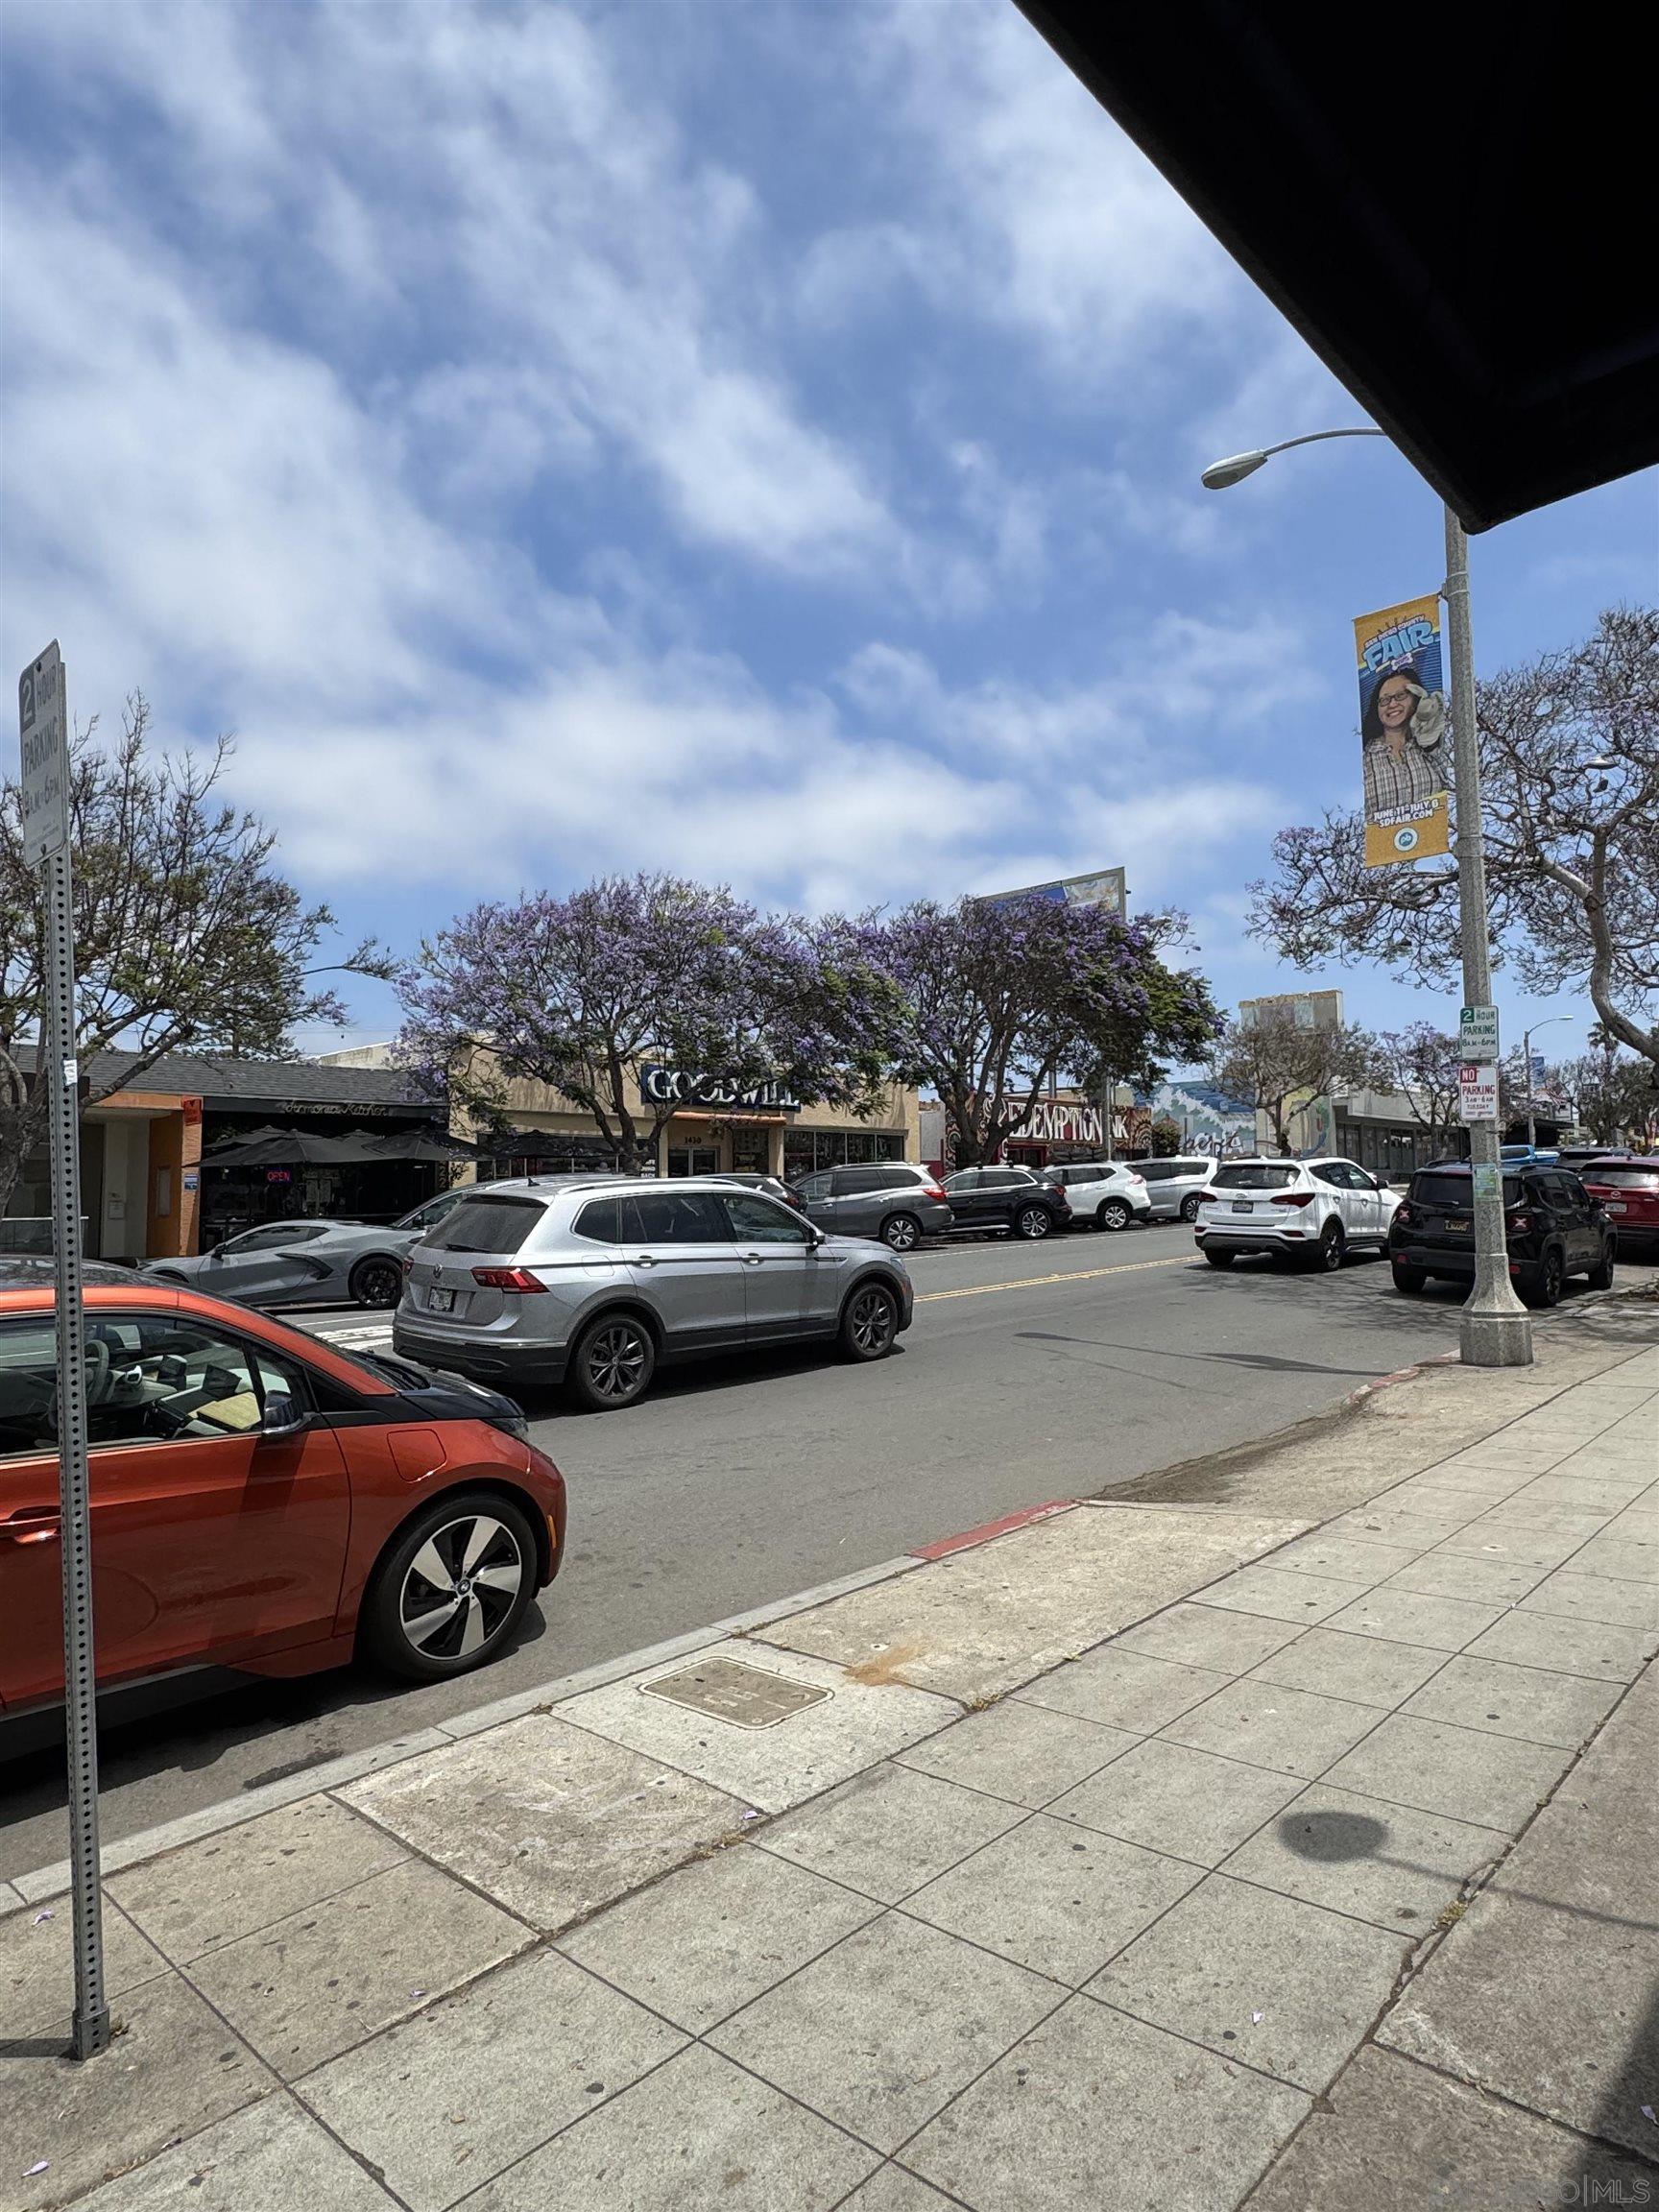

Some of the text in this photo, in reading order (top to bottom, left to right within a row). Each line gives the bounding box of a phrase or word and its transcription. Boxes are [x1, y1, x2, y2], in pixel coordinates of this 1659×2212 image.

[1398, 615, 1425, 630] COUNTY
[1363, 621, 1433, 671] FAIR
[22, 665, 58, 723] 2 HOUR
[23, 715, 59, 778] PARKING
[1374, 808, 1395, 822] JUNE
[1379, 809, 1433, 828] SDFAIR.COM
[1463, 1010, 1496, 1022] 2 HOUR
[1463, 1024, 1496, 1036] PARKING
[1461, 1070, 1475, 1081] NO
[1462, 1085, 1495, 1095] PARKING
[267, 1171, 290, 1182] OPEN
